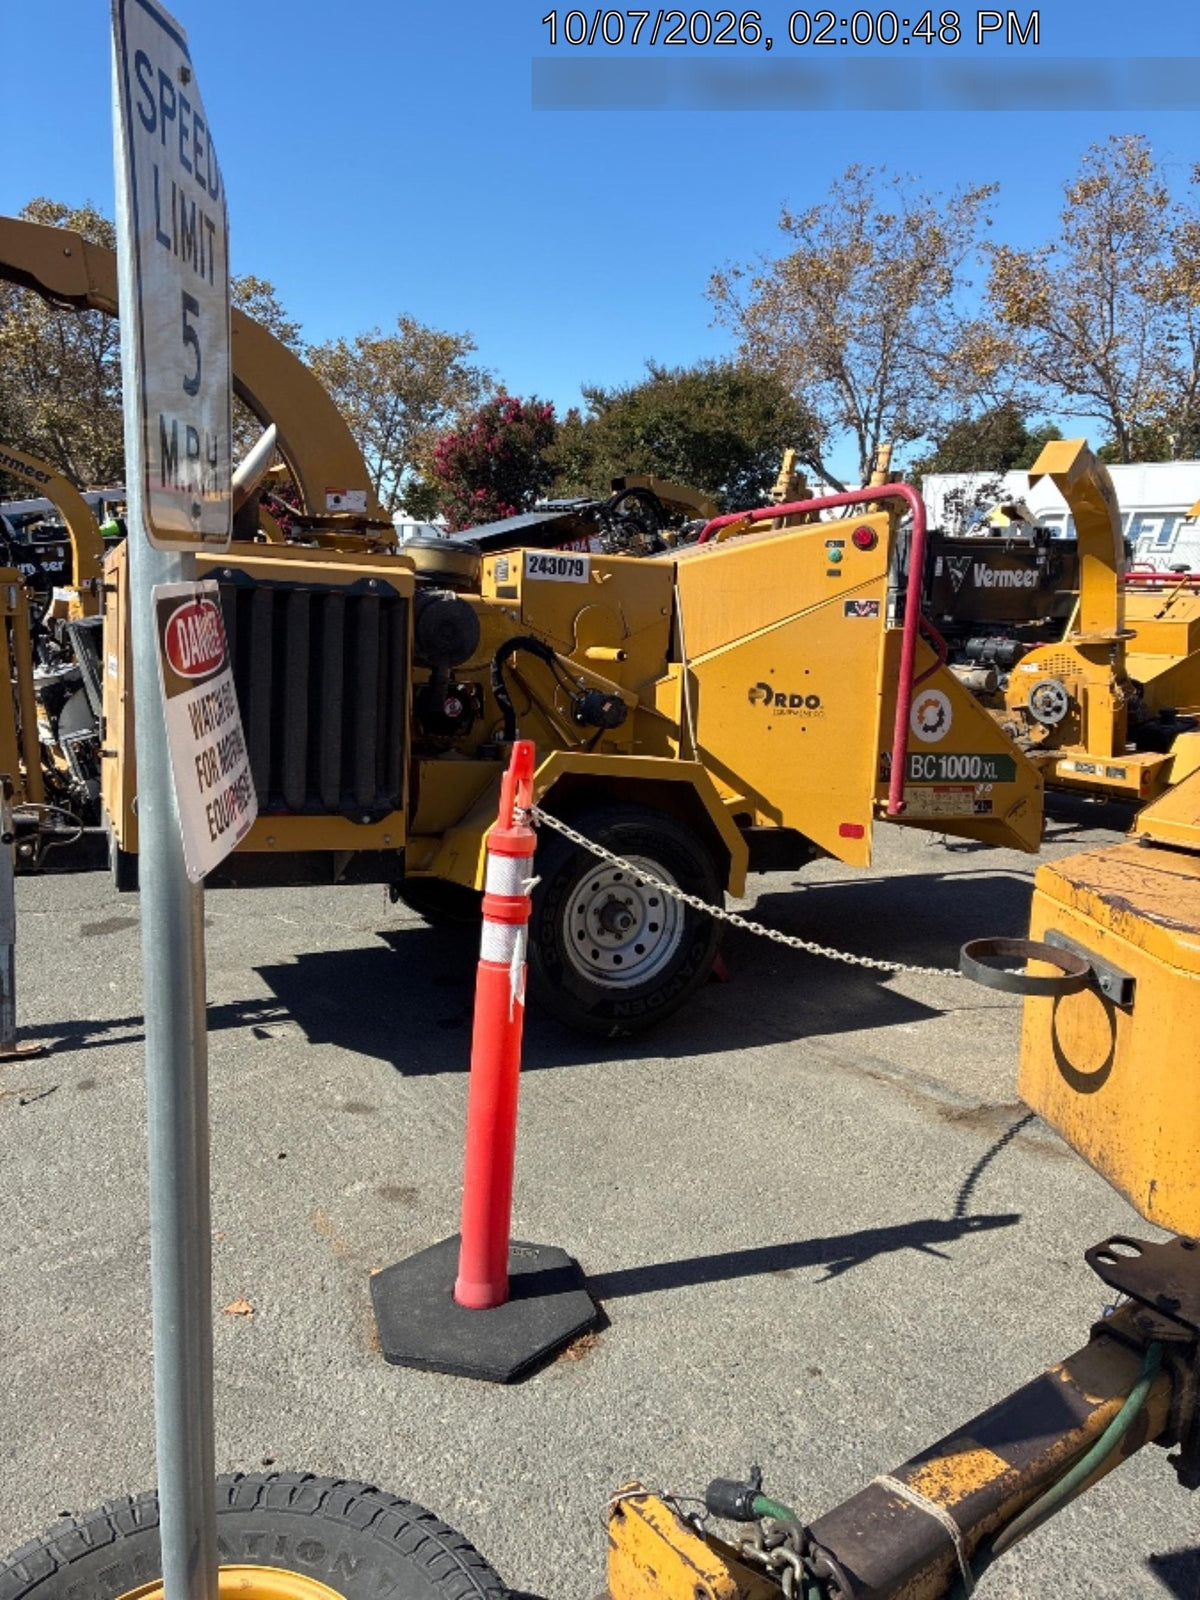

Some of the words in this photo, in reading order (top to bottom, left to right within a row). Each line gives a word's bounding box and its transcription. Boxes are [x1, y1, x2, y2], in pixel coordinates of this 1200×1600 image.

[134, 49, 219, 201] SPEED
[153, 164, 215, 287] LIMIT
[181, 289, 201, 397] 5
[529, 555, 585, 577] 243079
[974, 563, 1040, 588] Vermeer
